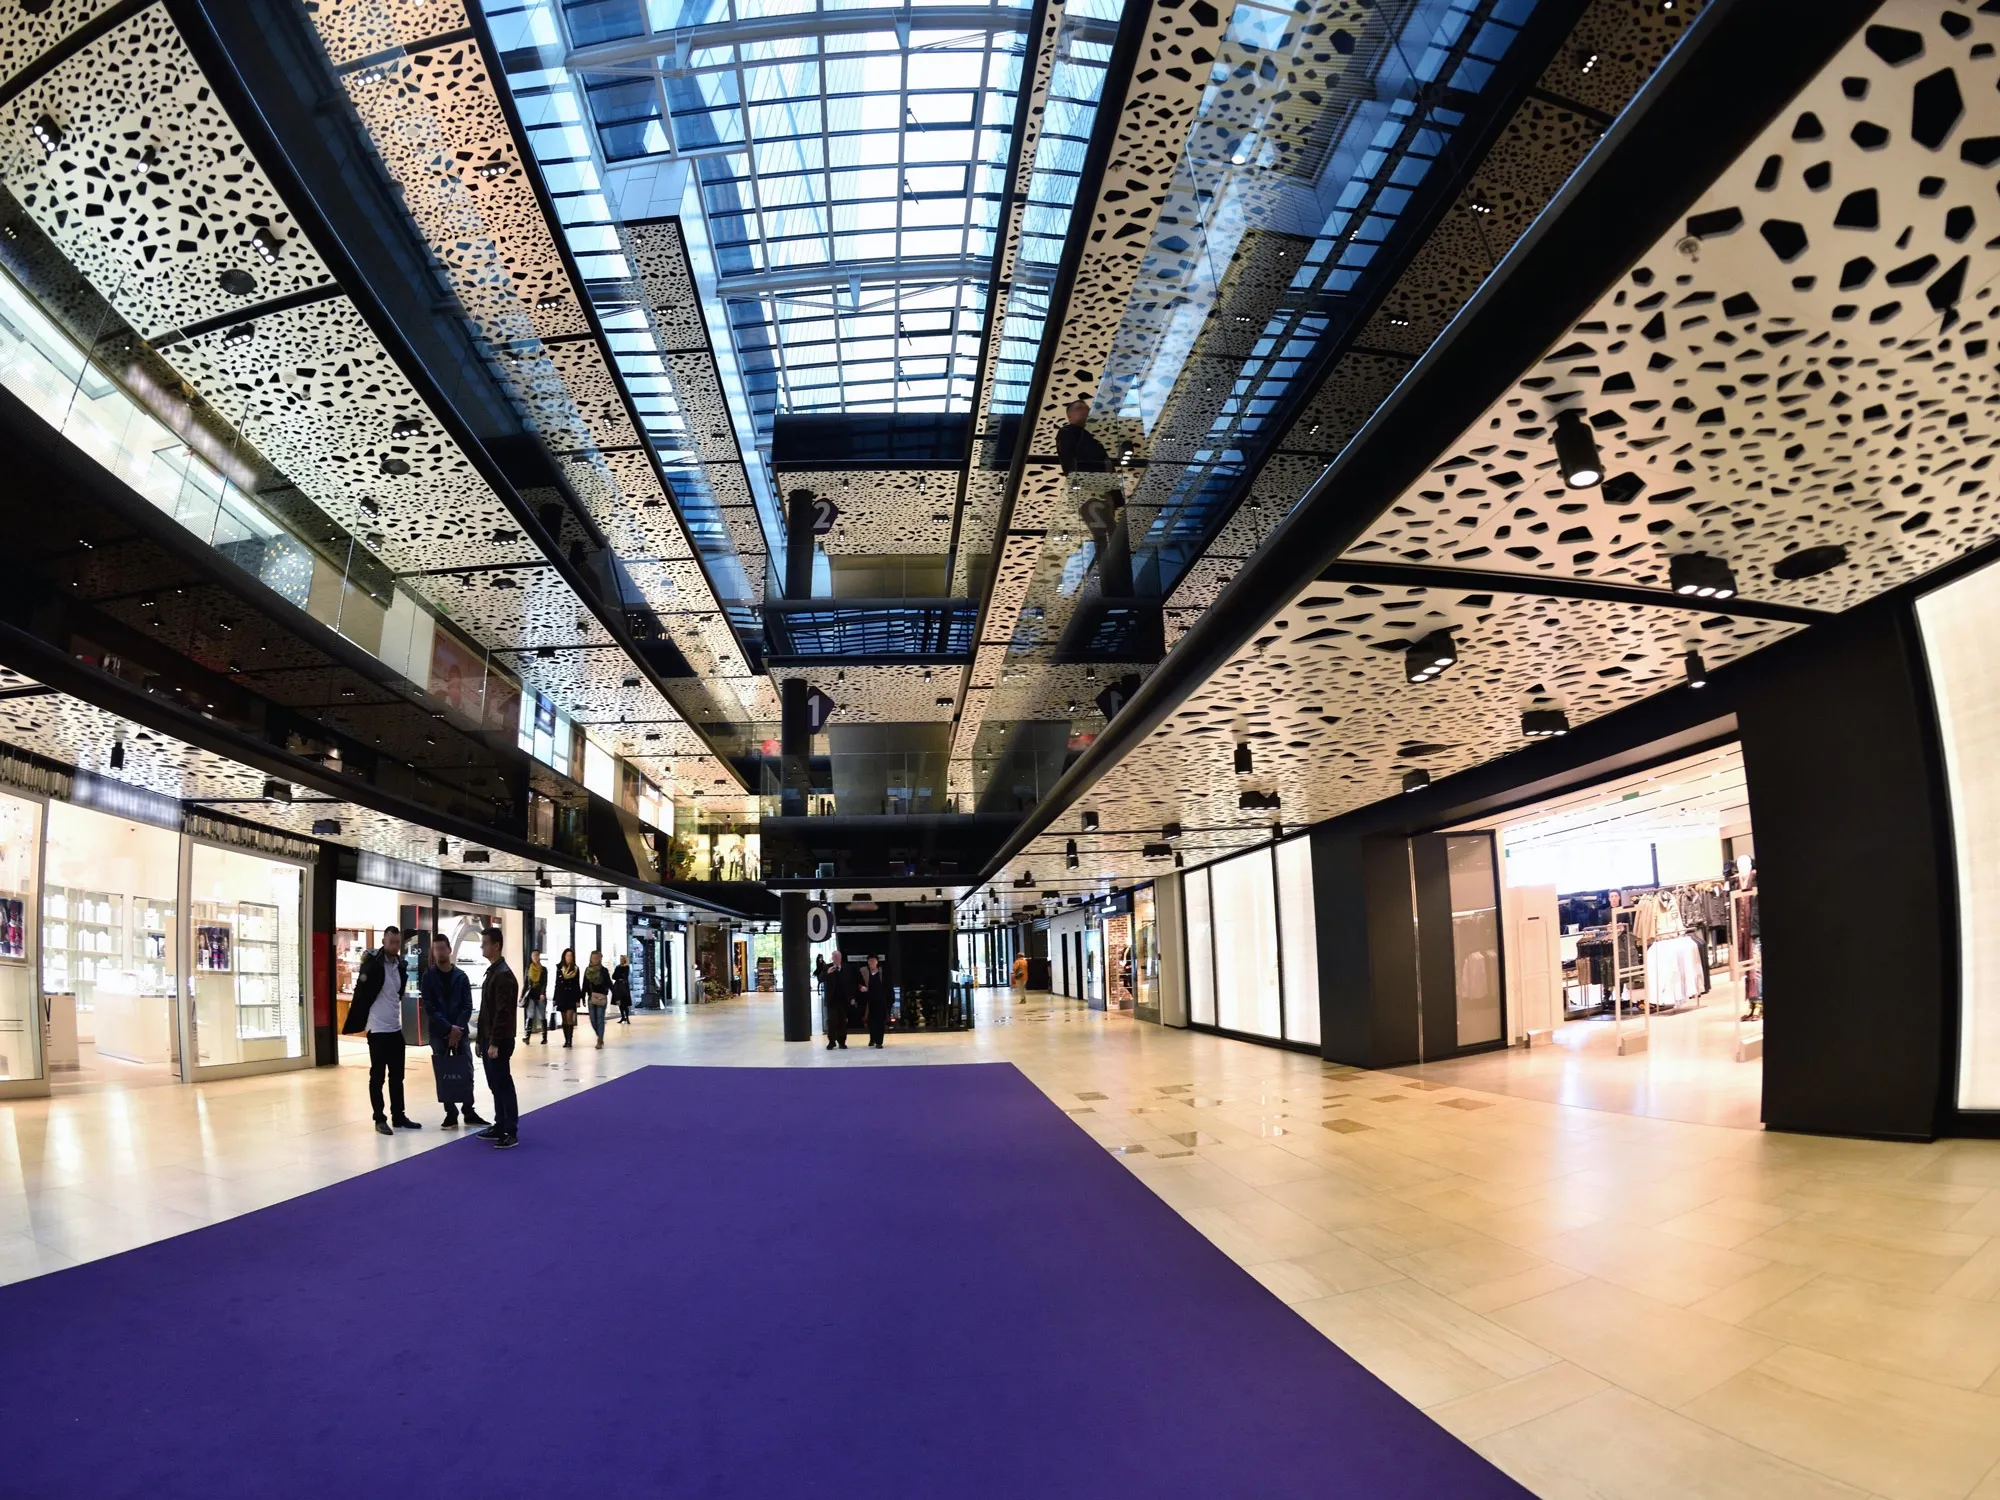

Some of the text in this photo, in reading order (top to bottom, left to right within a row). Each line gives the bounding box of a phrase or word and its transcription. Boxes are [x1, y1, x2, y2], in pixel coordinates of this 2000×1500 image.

[813, 501, 831, 529] 2
[807, 694, 820, 727] 1
[807, 906, 828, 941] 0
